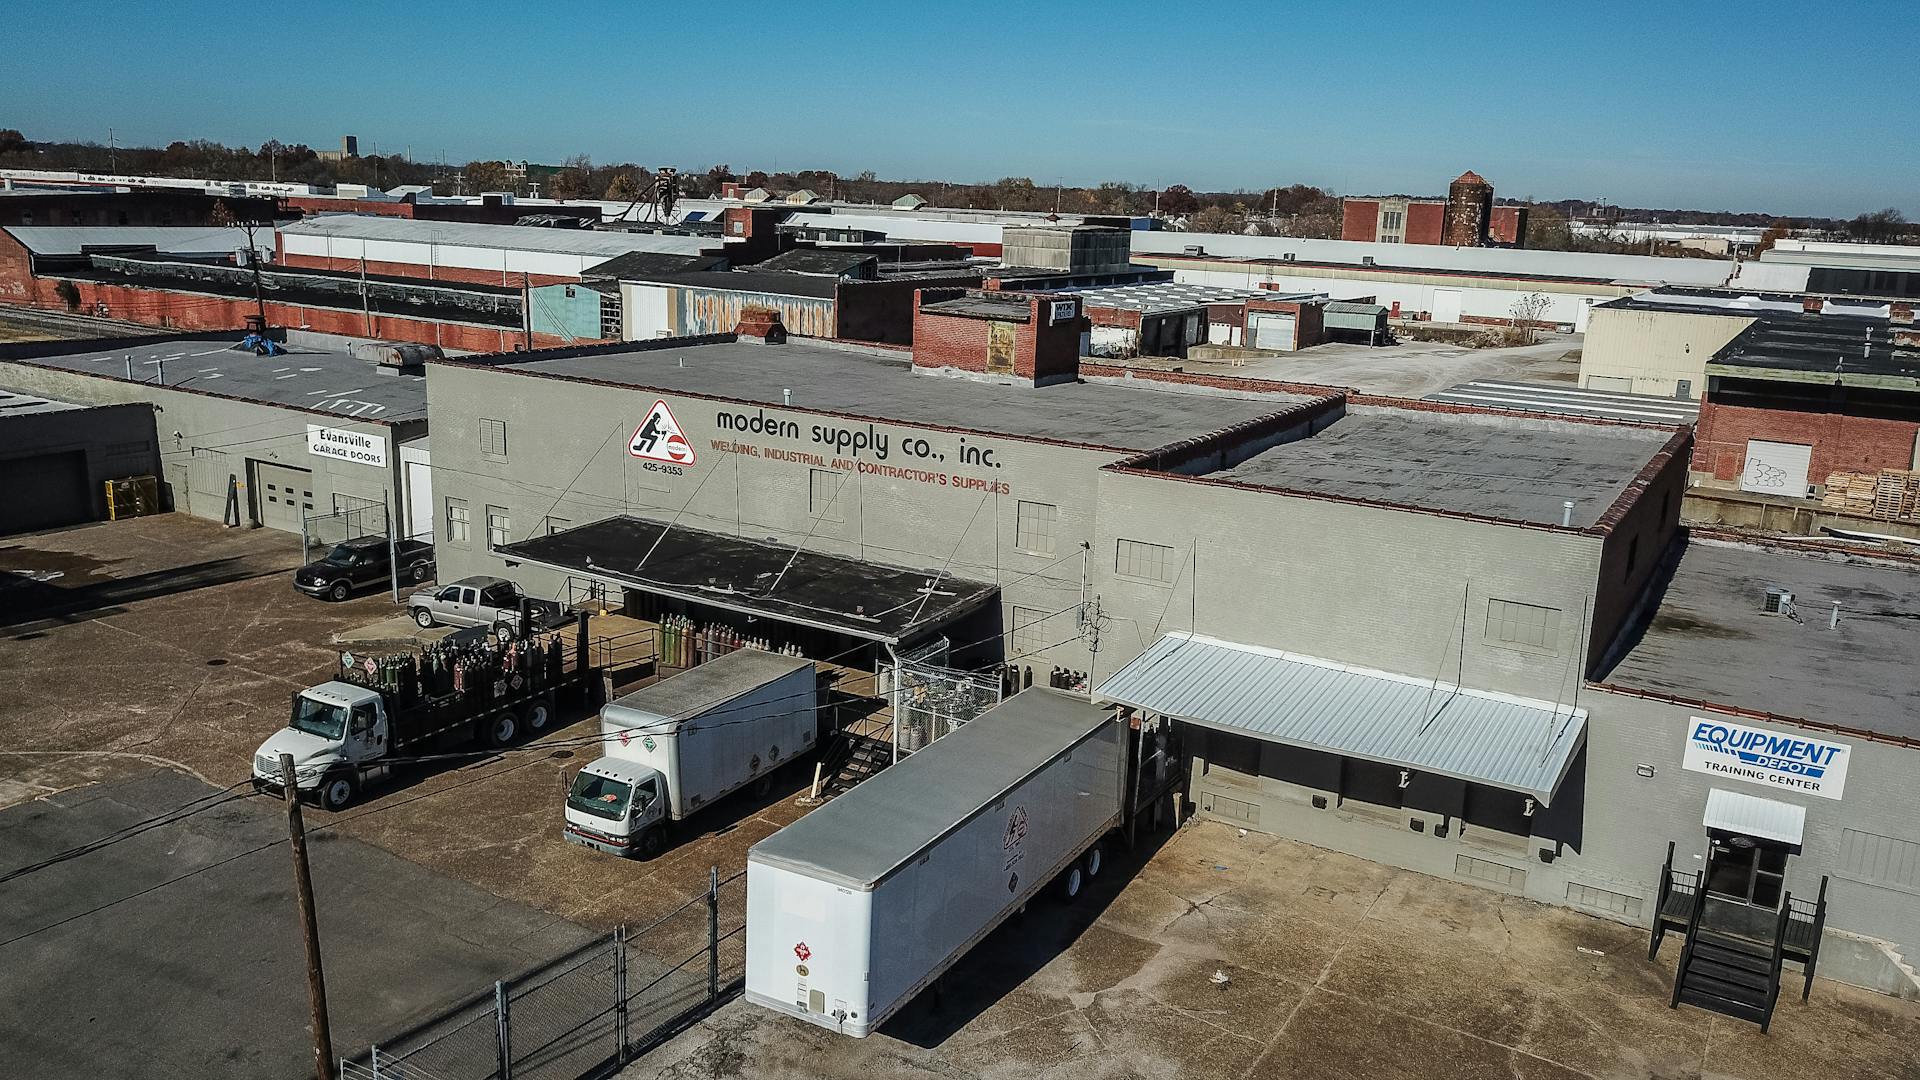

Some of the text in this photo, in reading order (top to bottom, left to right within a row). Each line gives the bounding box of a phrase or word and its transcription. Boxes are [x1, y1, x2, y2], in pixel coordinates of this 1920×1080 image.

[1056, 303, 1073, 311] WIX
[320, 429, 372, 448] Evansville
[717, 409, 1001, 468] modern supply co., inc.
[313, 444, 381, 463] GARAGE DOORS
[642, 462, 683, 476] 425-9353
[710, 440, 1010, 495] WELDING, INDUSTRIAL AND CONTRACTOR'S SUPPLIES
[1692, 722, 1841, 765] EQUIPMENT
[1757, 756, 1810, 774] DEPOT
[1704, 761, 1821, 791] TRAINING CENTER
